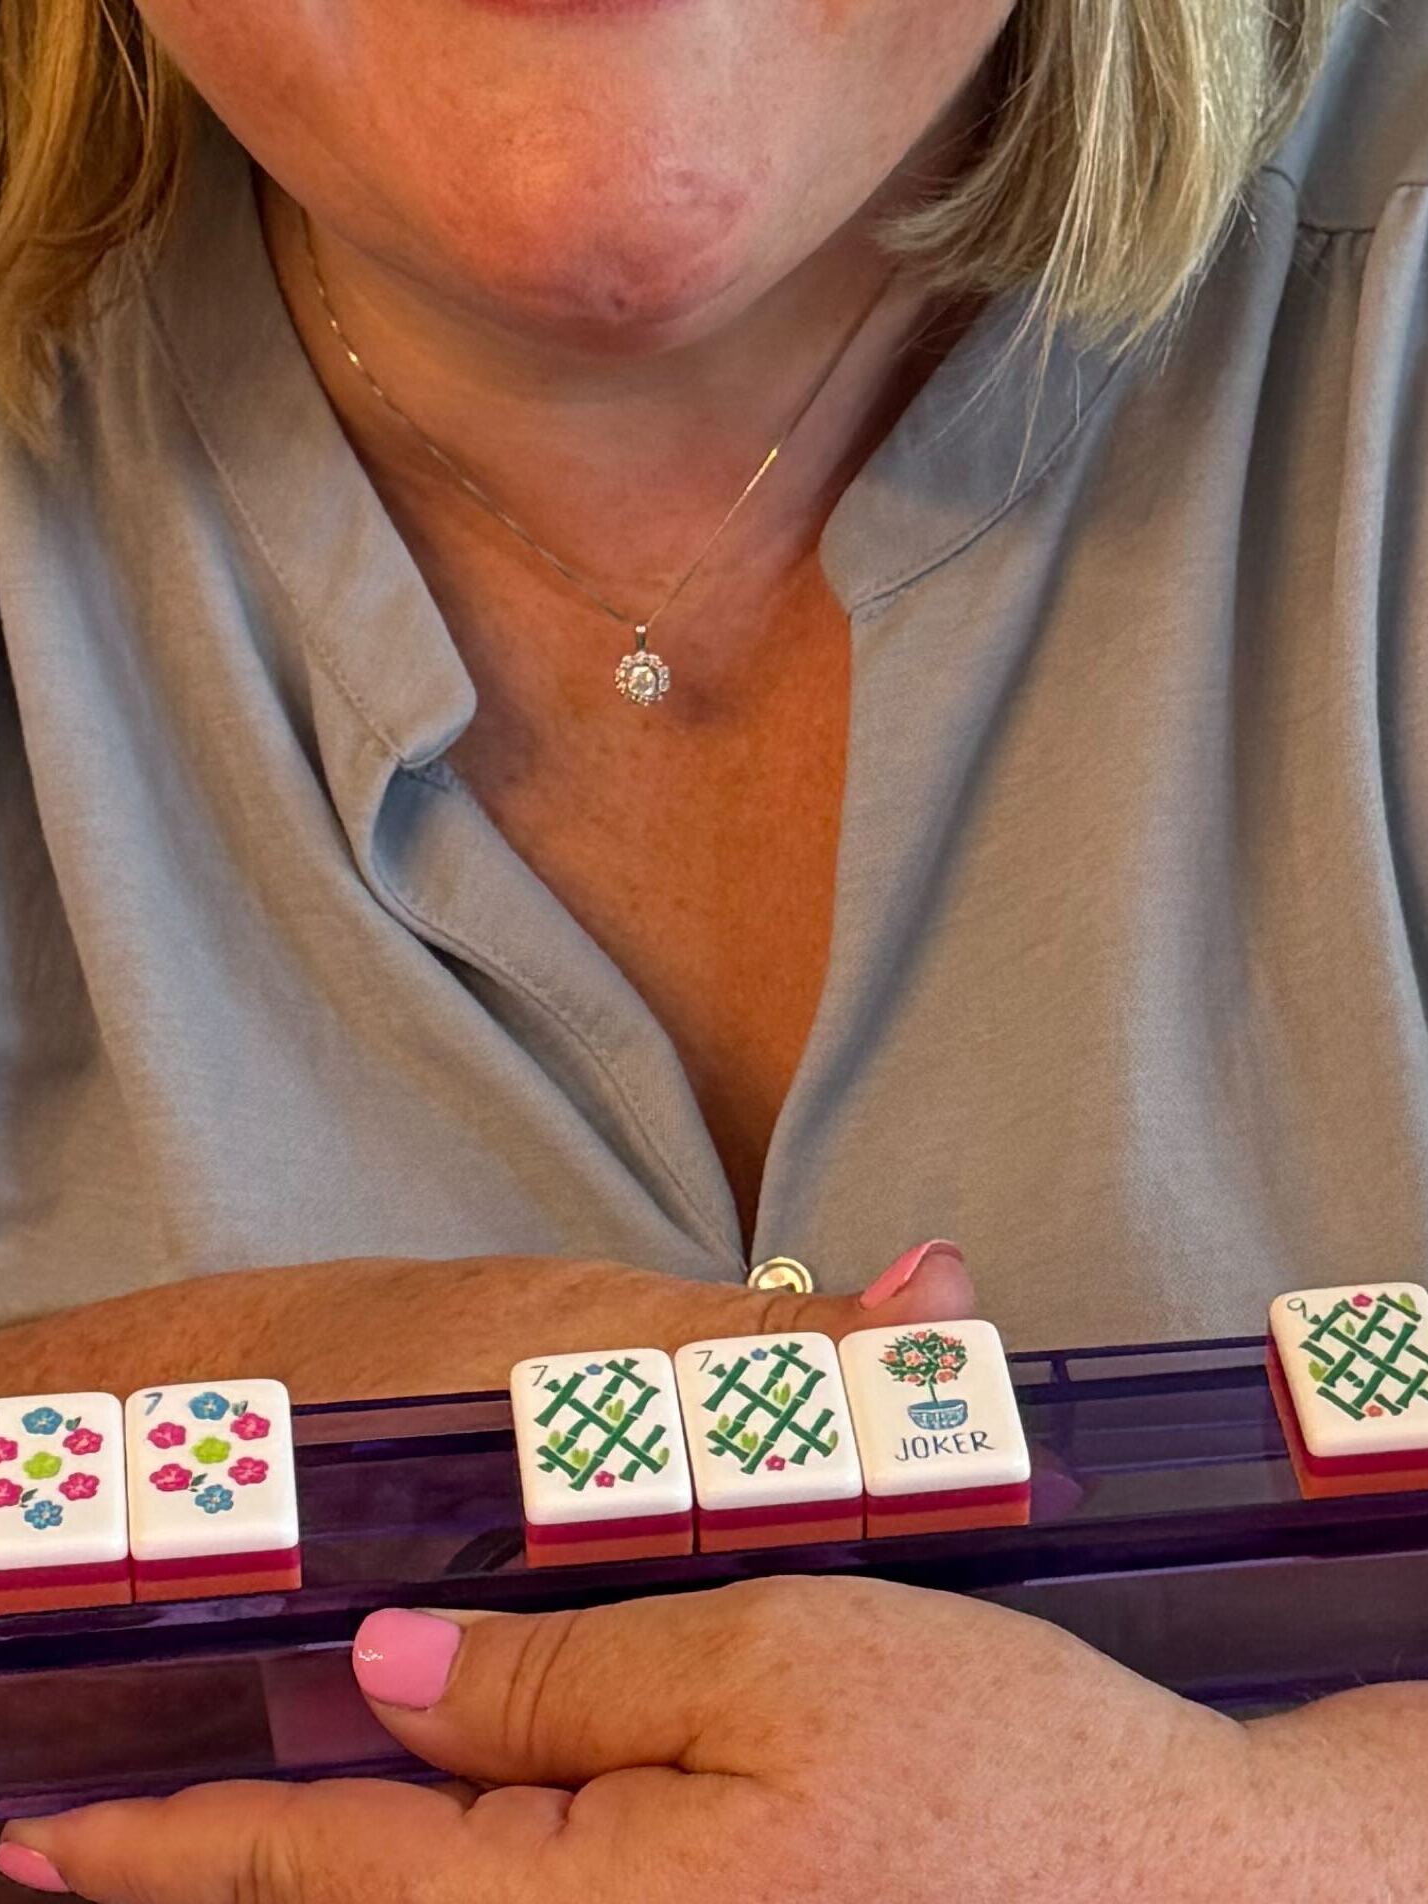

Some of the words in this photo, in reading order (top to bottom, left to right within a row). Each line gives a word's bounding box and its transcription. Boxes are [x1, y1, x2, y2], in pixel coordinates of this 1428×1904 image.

[1289, 1296, 1310, 1320] 9
[694, 1346, 715, 1373] 7
[529, 1363, 550, 1386] 7
[145, 1393, 165, 1418] 7
[894, 1428, 995, 1464] JOKER
